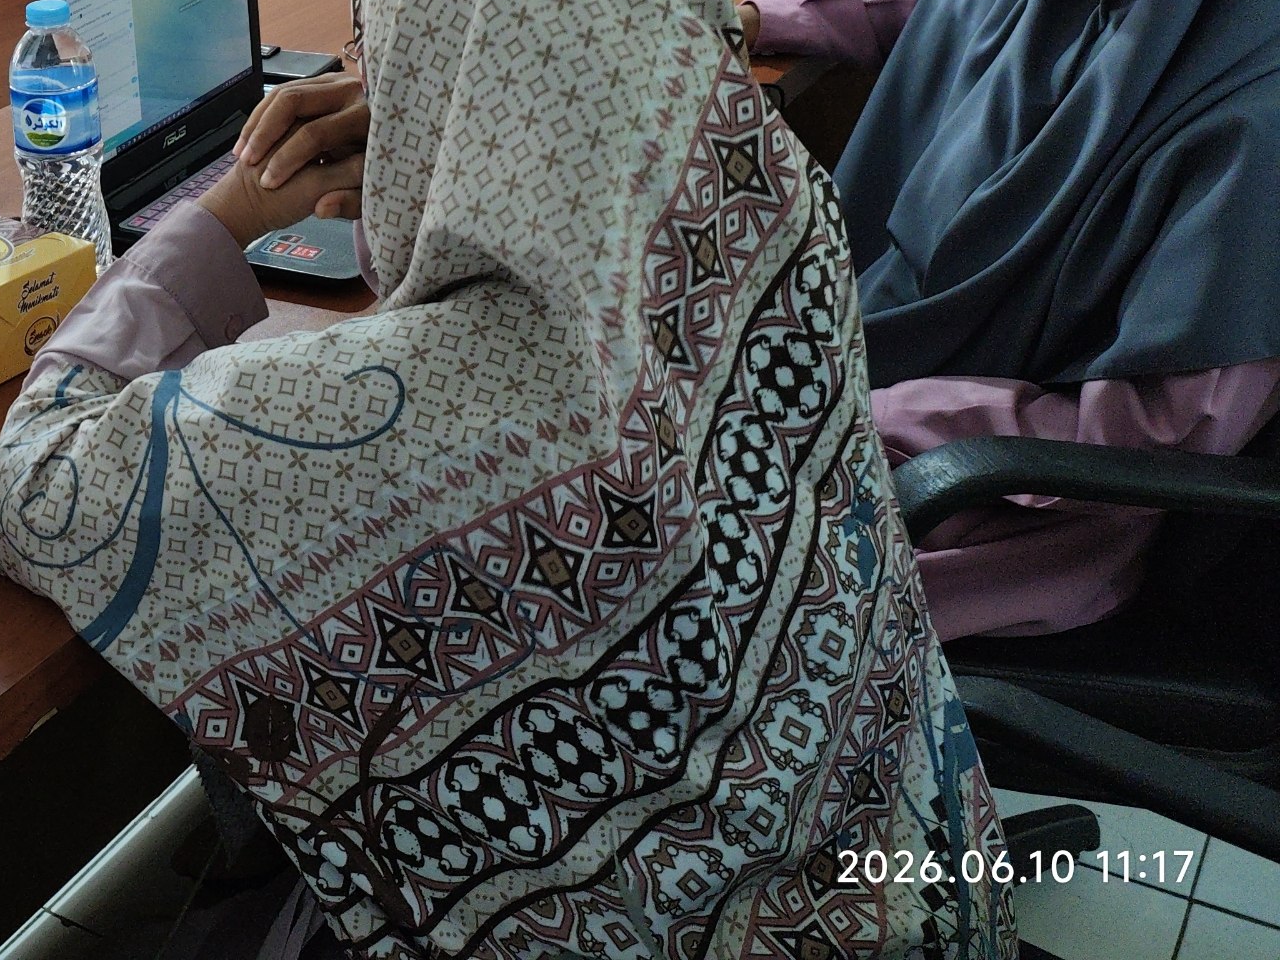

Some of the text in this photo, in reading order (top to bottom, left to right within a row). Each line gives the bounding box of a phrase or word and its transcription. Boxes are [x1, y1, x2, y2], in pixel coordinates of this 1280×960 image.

[162, 124, 187, 149] ASUS
[17, 285, 60, 314] Menikmati
[21, 271, 57, 300] Selamat
